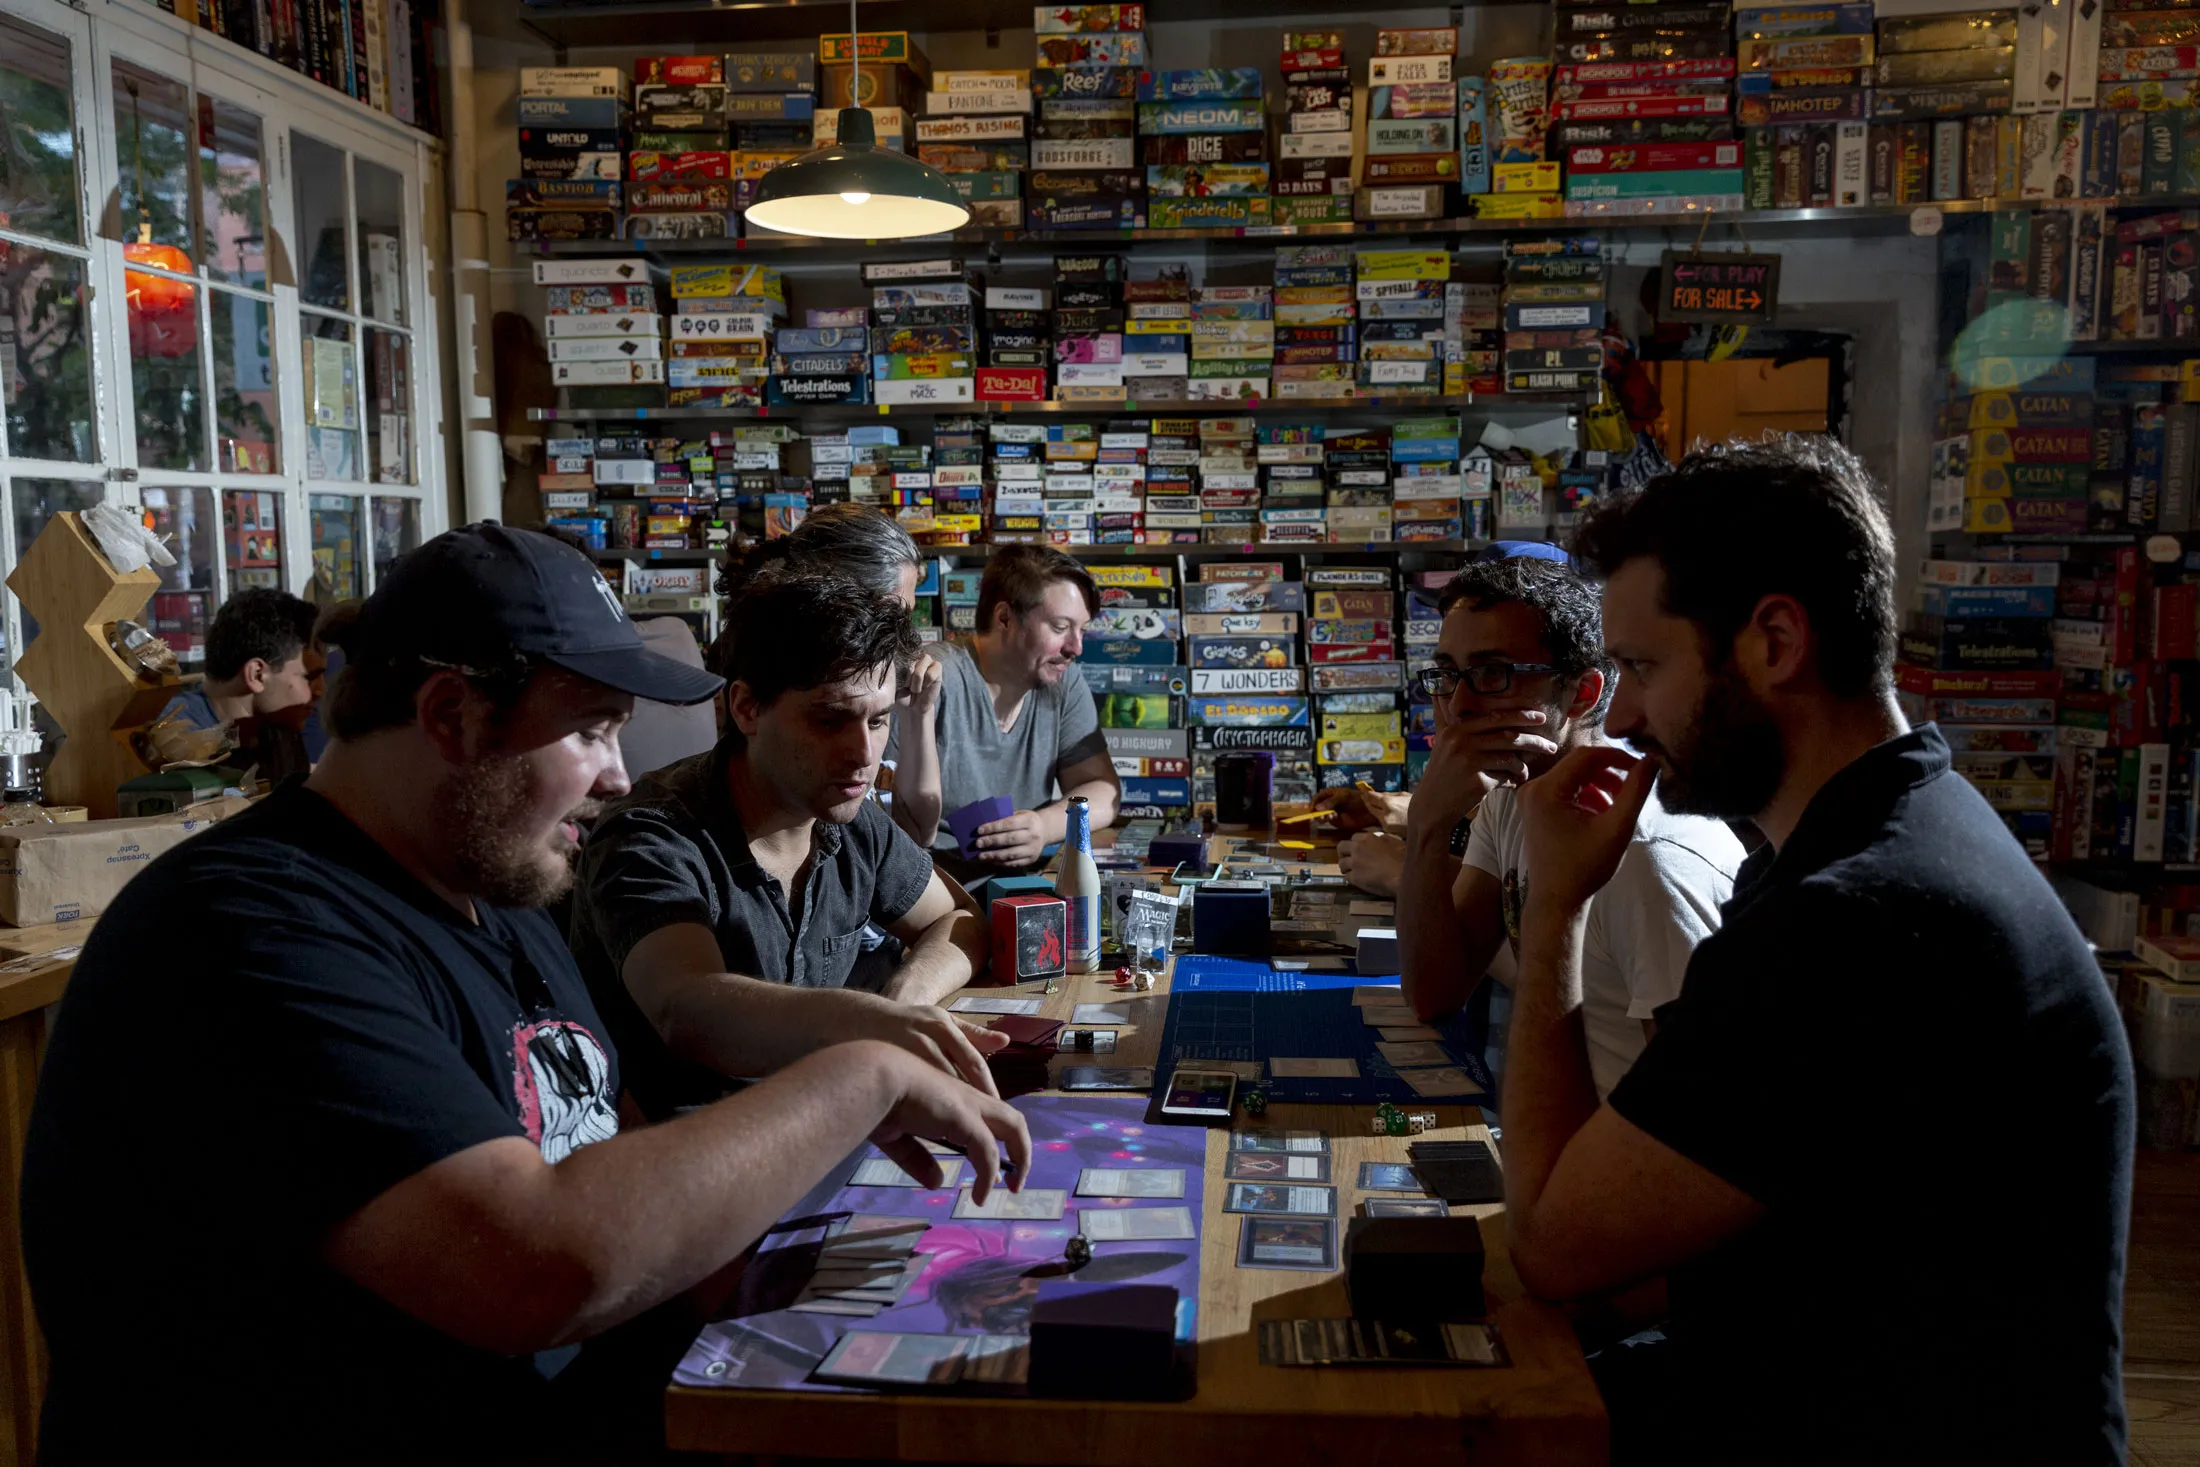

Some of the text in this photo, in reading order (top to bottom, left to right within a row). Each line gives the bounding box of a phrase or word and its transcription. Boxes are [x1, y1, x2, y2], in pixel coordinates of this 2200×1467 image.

[1572, 13, 1616, 30] Risk
[520, 101, 570, 114] PORTAL
[1771, 97, 1843, 113] IMHOTEP
[1164, 108, 1239, 125] NEOM
[918, 119, 1021, 137] THANOS RISING
[1565, 126, 1613, 141] Risk
[546, 132, 589, 144] UNTOLD
[1187, 136, 1222, 152] DICE
[1037, 150, 1102, 164] GODSFORGE
[1278, 181, 1323, 194] 13 DAYS
[1570, 185, 1619, 197] SUSPICION
[1166, 201, 1246, 220] Spinderella
[1695, 265, 1767, 283] FOR PLAY
[1376, 283, 1414, 296] SPYFALL
[1673, 288, 1745, 310] FOR SALE
[727, 323, 754, 333] BRAIN
[791, 356, 843, 372] CITADELS
[780, 378, 851, 393] Telestrations
[1529, 373, 1579, 388] FLASH POINT
[2020, 397, 2070, 412] CATAN
[2014, 437, 2068, 452] CATAN
[2015, 468, 2065, 483] CATAN
[2015, 501, 2065, 516] CATAN
[1196, 671, 1299, 690] 7 WONDERS
[1205, 704, 1290, 717] EL DORADO
[106, 852, 151, 864] Xpressnap
[56, 910, 80, 921] TORK
